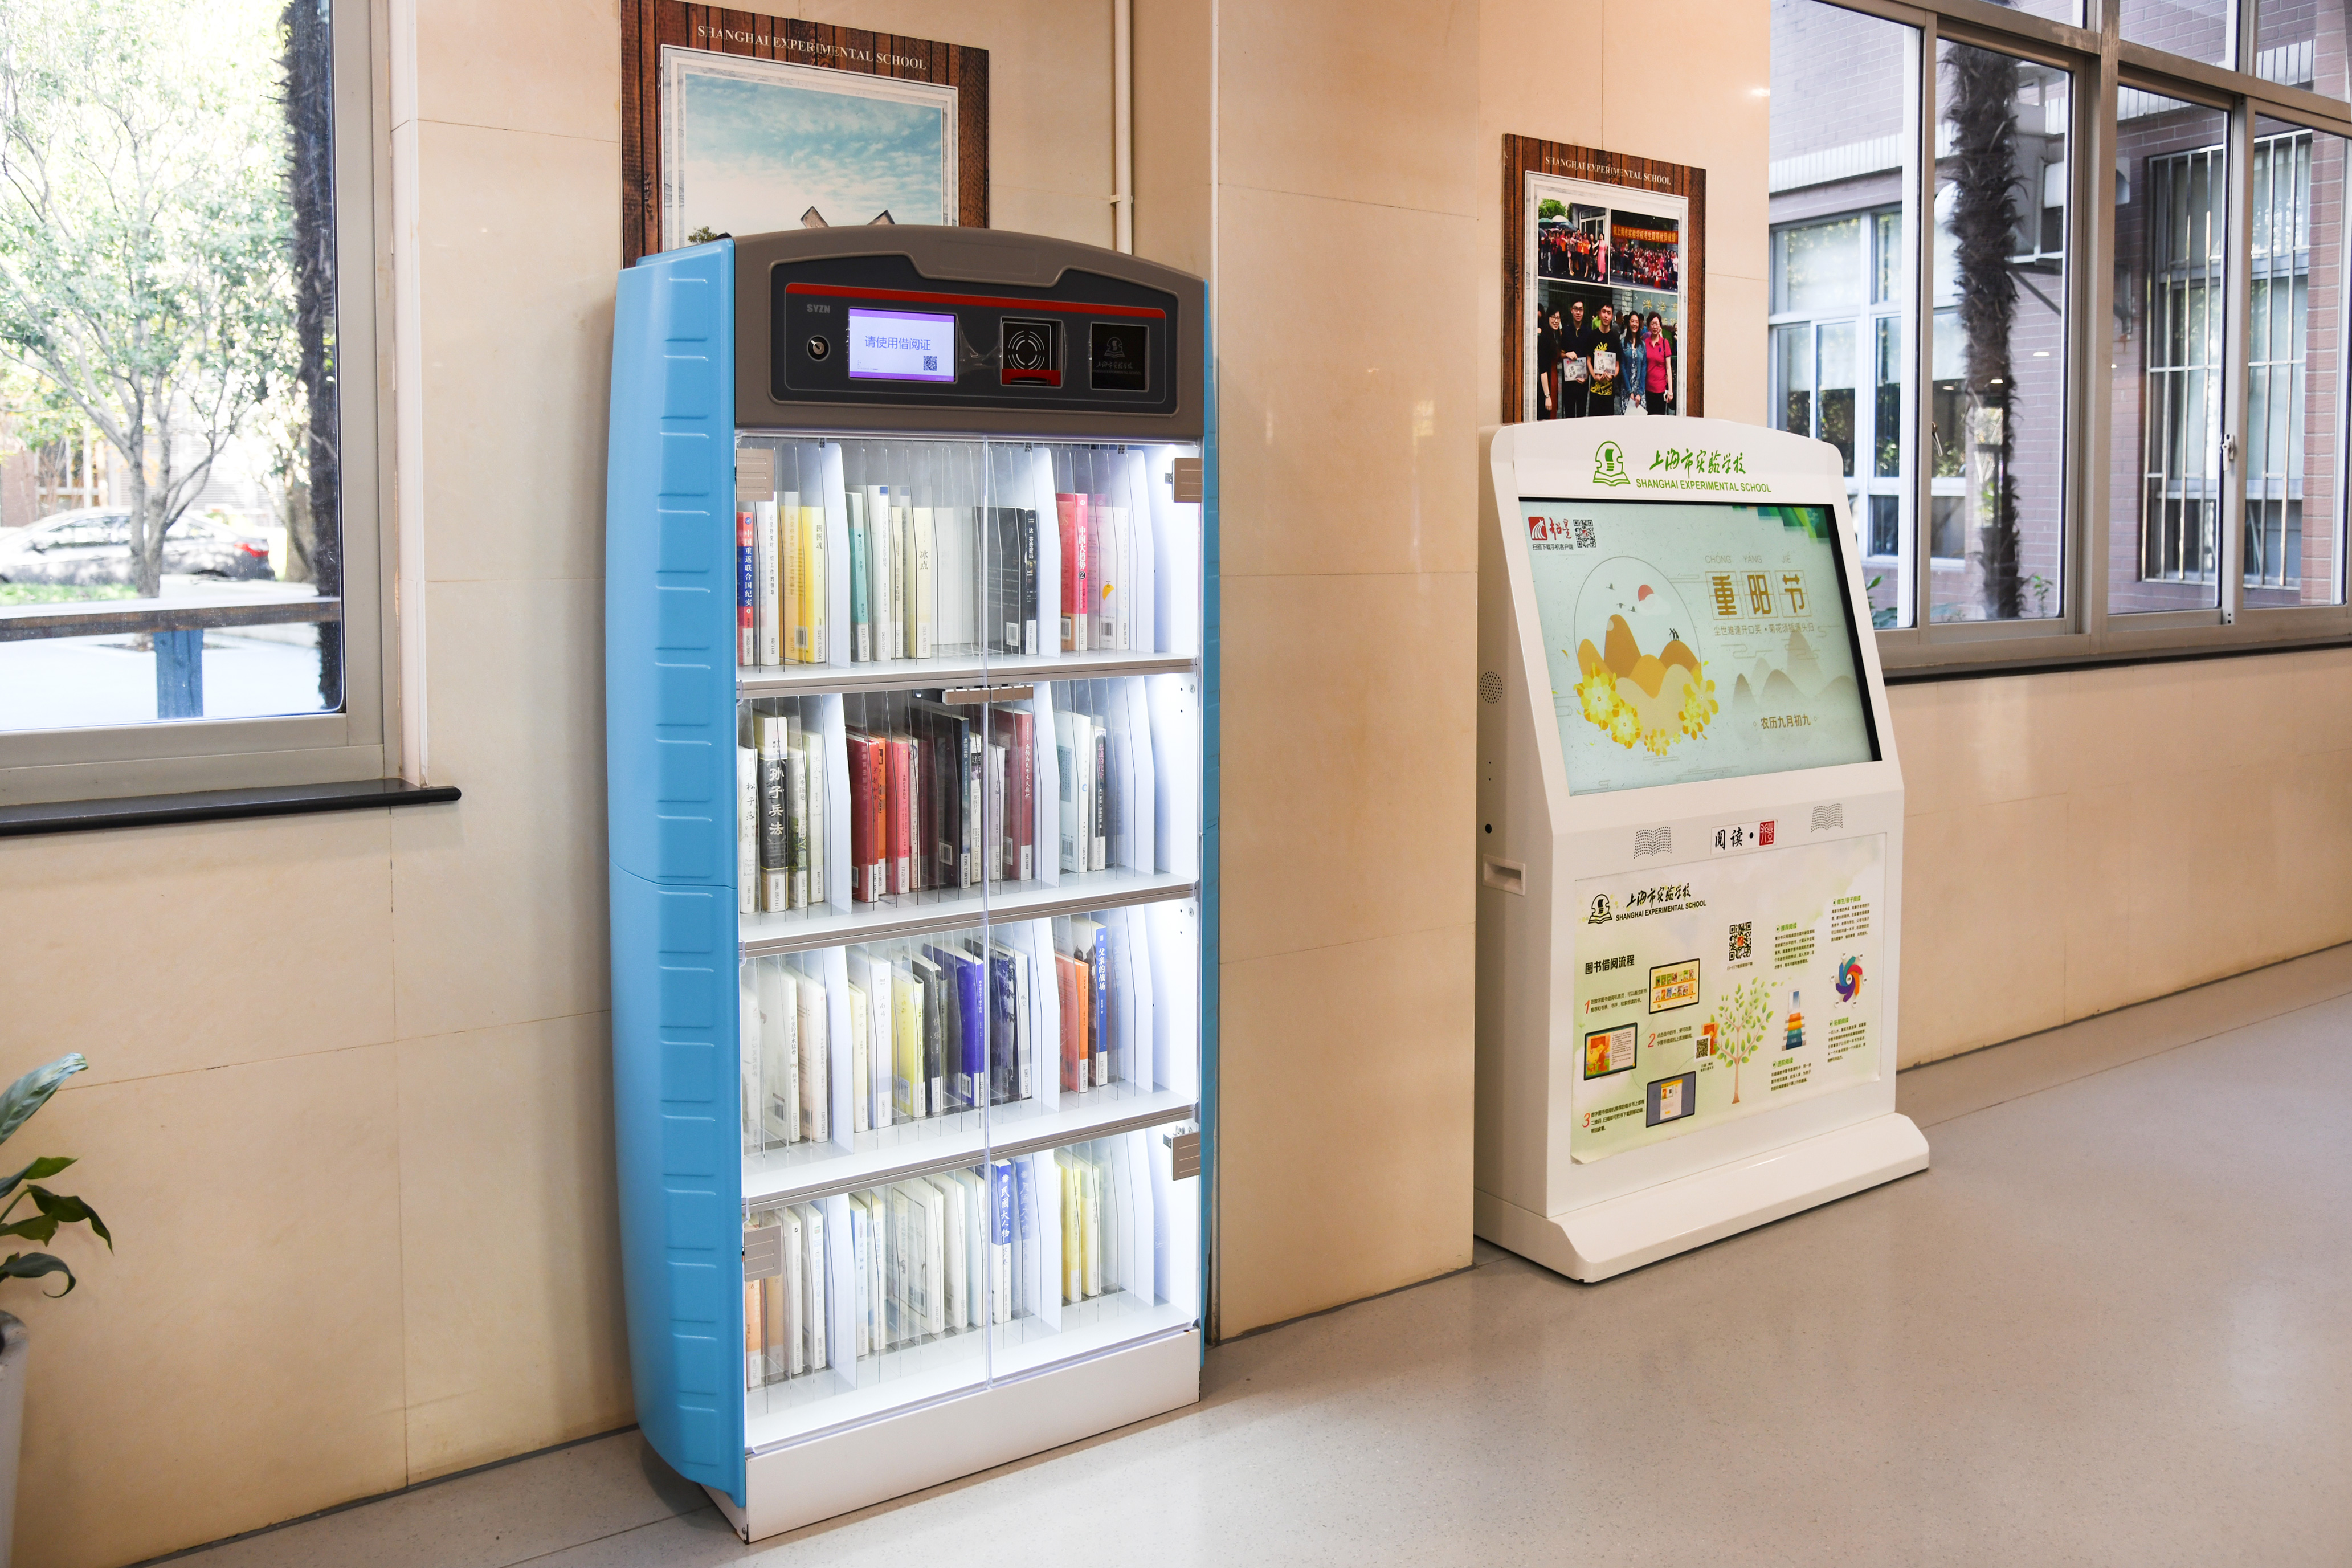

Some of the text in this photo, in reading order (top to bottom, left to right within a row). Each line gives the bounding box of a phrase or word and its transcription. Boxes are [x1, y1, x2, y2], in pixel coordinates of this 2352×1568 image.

[697, 26, 927, 70] SHANGHAI EXPERIMENTAL SCHOOL
[1545, 156, 1671, 185] SHANGHAI EXPERIMENTAL SCHOOL
[807, 304, 831, 315] SYZN
[865, 336, 931, 350] 请使用借阅证
[1649, 448, 1746, 479] 上海市实验学校
[1636, 478, 1771, 493] SHANGHAI EXPERIMENTAL SCHOOL
[920, 550, 928, 570] 冰点
[1078, 571, 1085, 579] 2
[1712, 574, 1805, 616] 重阳节
[1761, 714, 1811, 730] 农历九月初九
[746, 783, 756, 820] 松子落
[769, 767, 785, 836] 孙子兵法
[1626, 883, 1692, 908] 上海市实验学校
[1616, 900, 1706, 921] SHANGHAI EXPERIMENTAL SCHOOL
[1585, 954, 1635, 974] 图书借阅流程
[1585, 1000, 1590, 1014] 1
[933, 1018, 940, 1041] 快乐
[1648, 1033, 1656, 1048] 2
[1582, 1113, 1591, 1128] 3
[1001, 1187, 1010, 1243] 民國大人物
